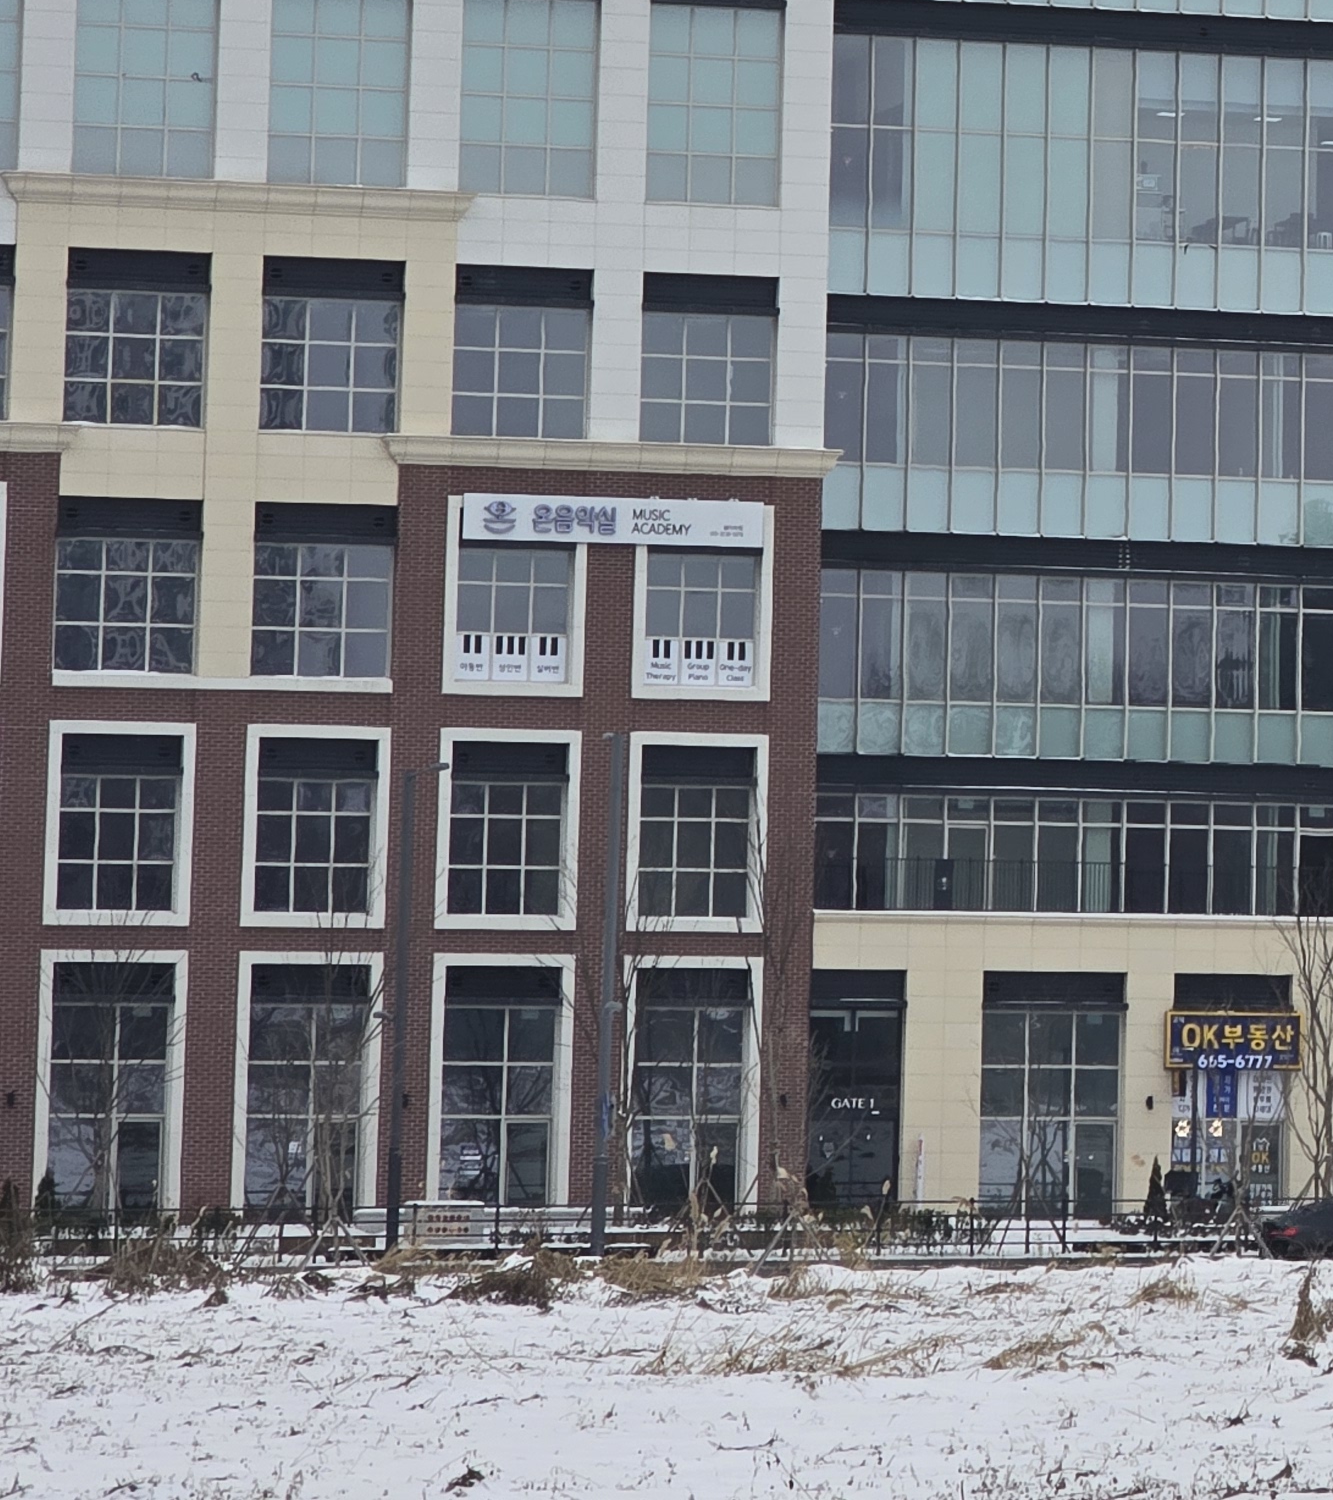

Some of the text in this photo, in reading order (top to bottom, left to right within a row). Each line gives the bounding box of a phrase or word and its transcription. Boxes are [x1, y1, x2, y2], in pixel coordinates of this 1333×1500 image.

[532, 503, 618, 536] 온음악실
[632, 509, 671, 522] MUSIC
[631, 523, 692, 536] ACADEMY
[650, 662, 672, 670] Music
[687, 663, 710, 671] Group
[720, 664, 752, 673] One-day
[646, 672, 677, 681] Therapy
[688, 673, 709, 681] Piano
[726, 674, 745, 682] Class
[1182, 1023, 1295, 1051] OK부동산
[831, 1097, 875, 1109] GATE 1
[1251, 1151, 1270, 1163] OK
